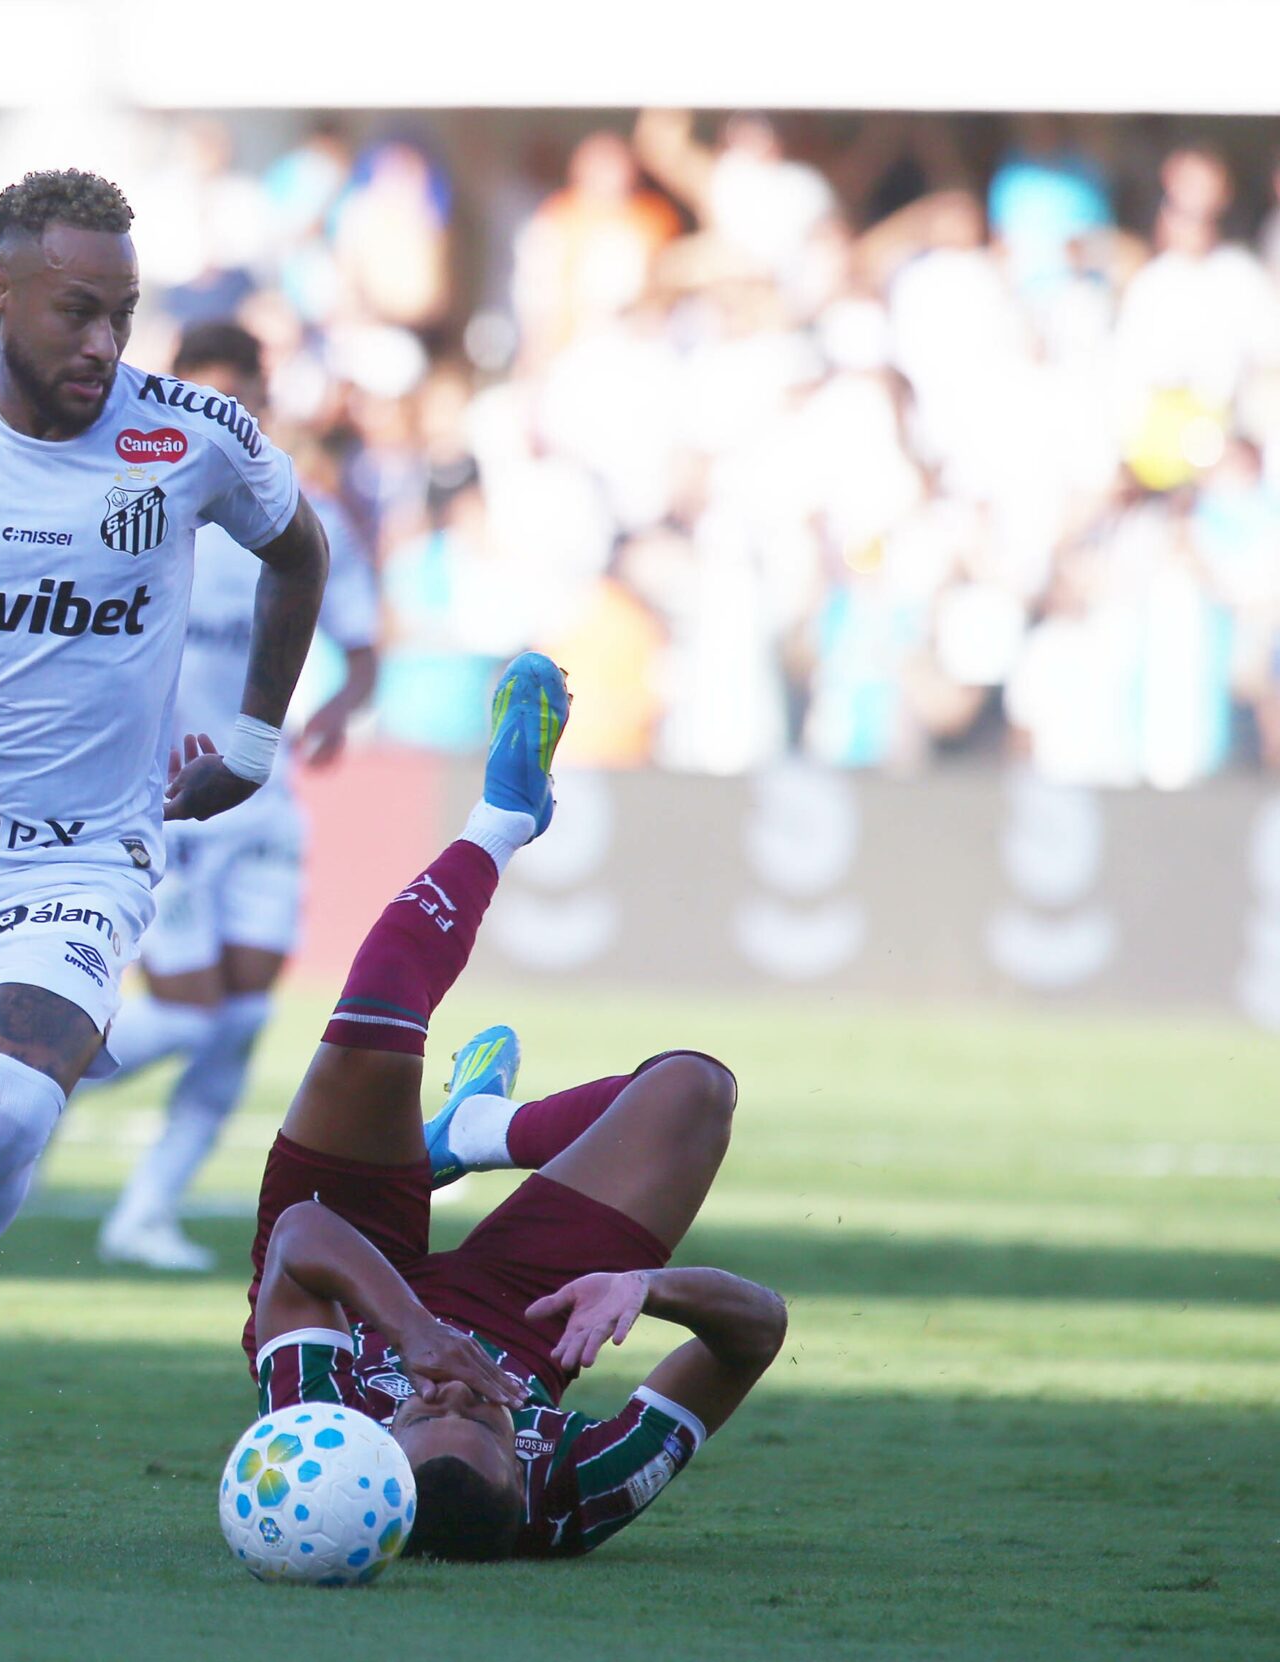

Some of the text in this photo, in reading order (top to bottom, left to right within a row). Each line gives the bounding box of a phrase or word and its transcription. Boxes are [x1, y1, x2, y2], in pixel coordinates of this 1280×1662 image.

[119, 436, 185, 457] Canção
[19, 529, 73, 547] nissei
[64, 953, 104, 988] umbro
